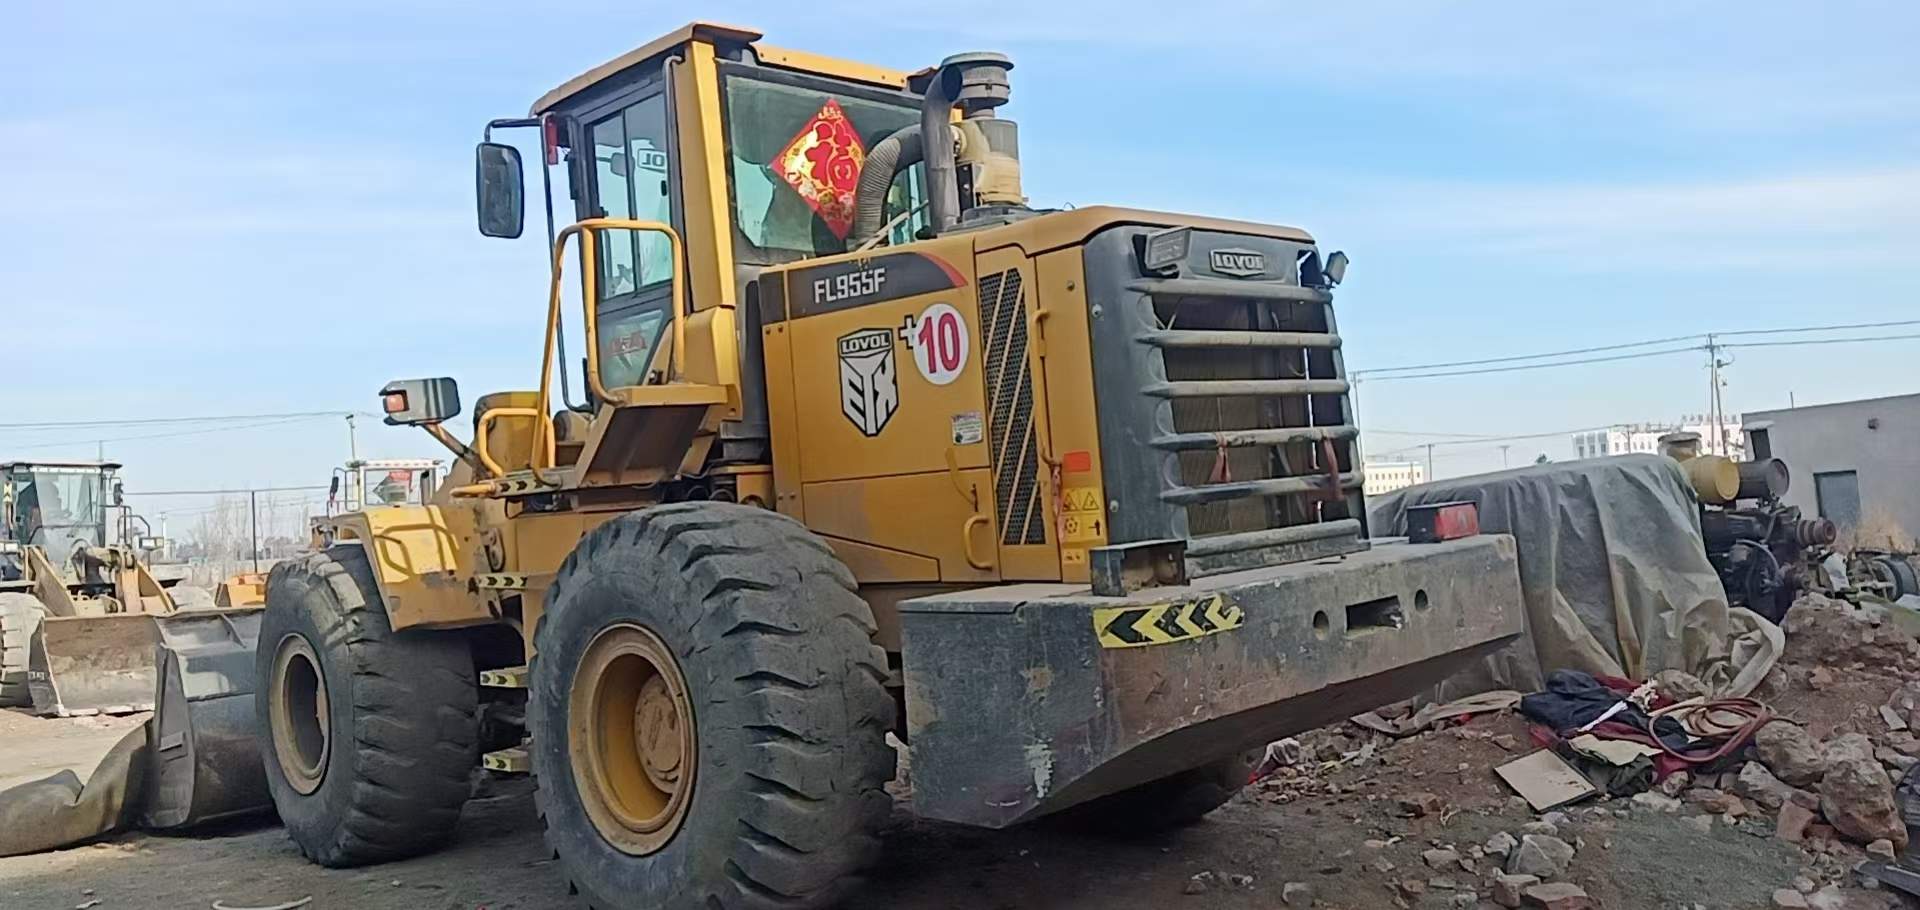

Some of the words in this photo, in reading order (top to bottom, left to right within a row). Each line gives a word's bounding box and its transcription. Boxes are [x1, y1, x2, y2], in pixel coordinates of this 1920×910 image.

[804, 121, 860, 192] 福
[813, 268, 887, 304] FL955F
[842, 333, 889, 352] LOVOL
